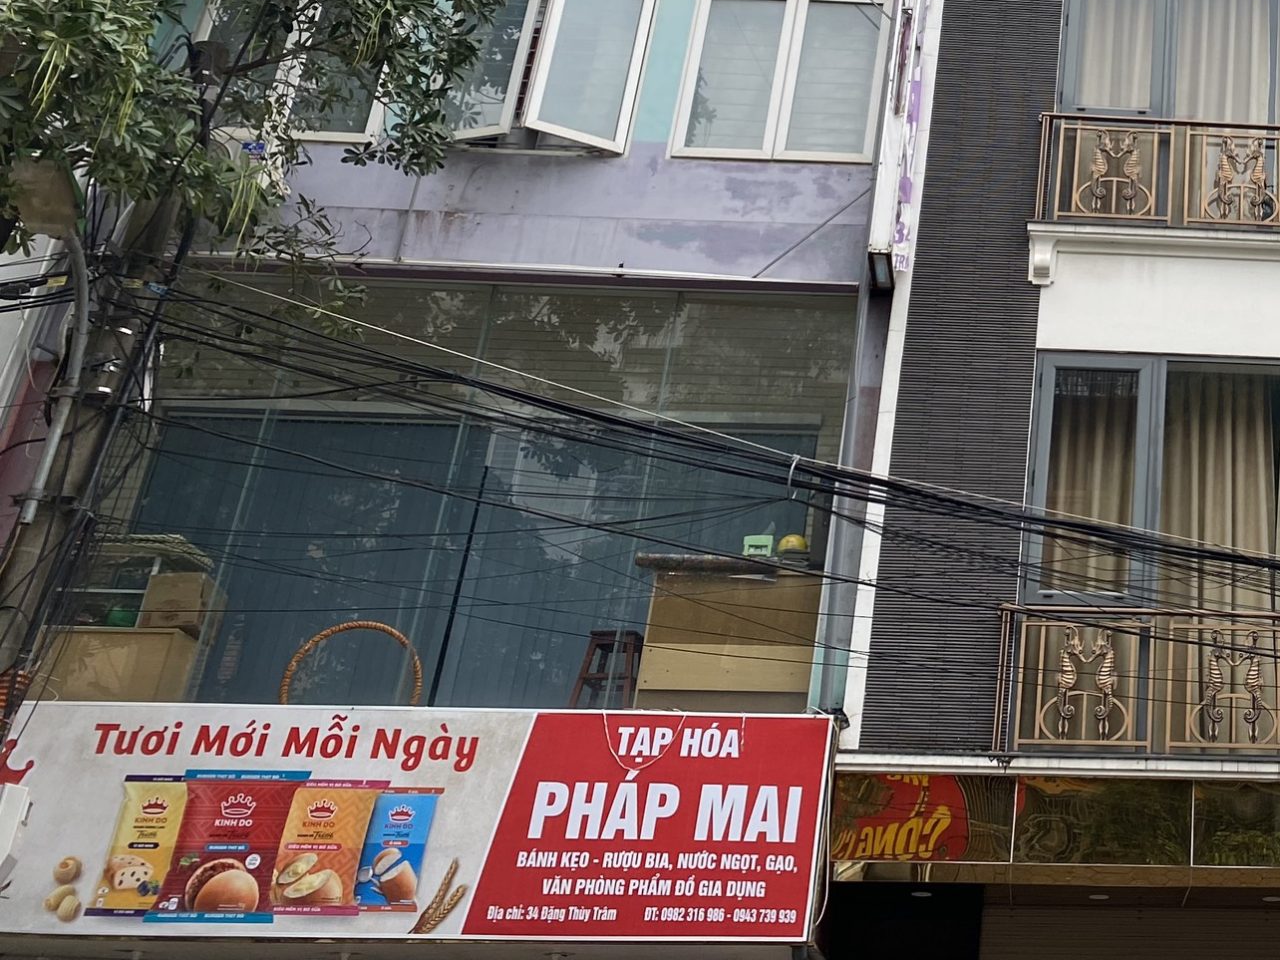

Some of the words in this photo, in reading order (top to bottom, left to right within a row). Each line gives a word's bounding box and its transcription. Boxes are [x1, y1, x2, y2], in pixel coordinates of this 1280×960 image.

[94, 721, 183, 756] Tươi
[191, 719, 271, 757] Mới
[282, 714, 361, 759] Mỗi
[371, 723, 480, 772] Ngày
[617, 726, 674, 763] TẠP
[680, 723, 740, 758] HÓA
[527, 769, 680, 840] PHÁP
[694, 784, 803, 843] MAI
[516, 848, 557, 868] BÁNH
[559, 852, 590, 874] KẸO
[602, 852, 641, 874] RƯỢU
[645, 853, 673, 872] BIA,
[677, 850, 717, 870] NƯỚC
[720, 853, 761, 875] NGỌT,
[765, 855, 797, 876] GẠO,
[542, 875, 573, 895] VĂN
[576, 874, 625, 896] PHÒNG
[628, 874, 672, 896] PHẨM
[675, 875, 695, 897] ĐỒ
[698, 880, 722, 897] GIA
[726, 881, 766, 900] DỤNG
[526, 906, 539, 920] 34
[661, 907, 685, 921] 0982
[686, 908, 705, 922] 316
[706, 908, 725, 922] 986
[733, 908, 756, 922] 0943
[759, 909, 779, 923] 739
[779, 909, 797, 923] 939
